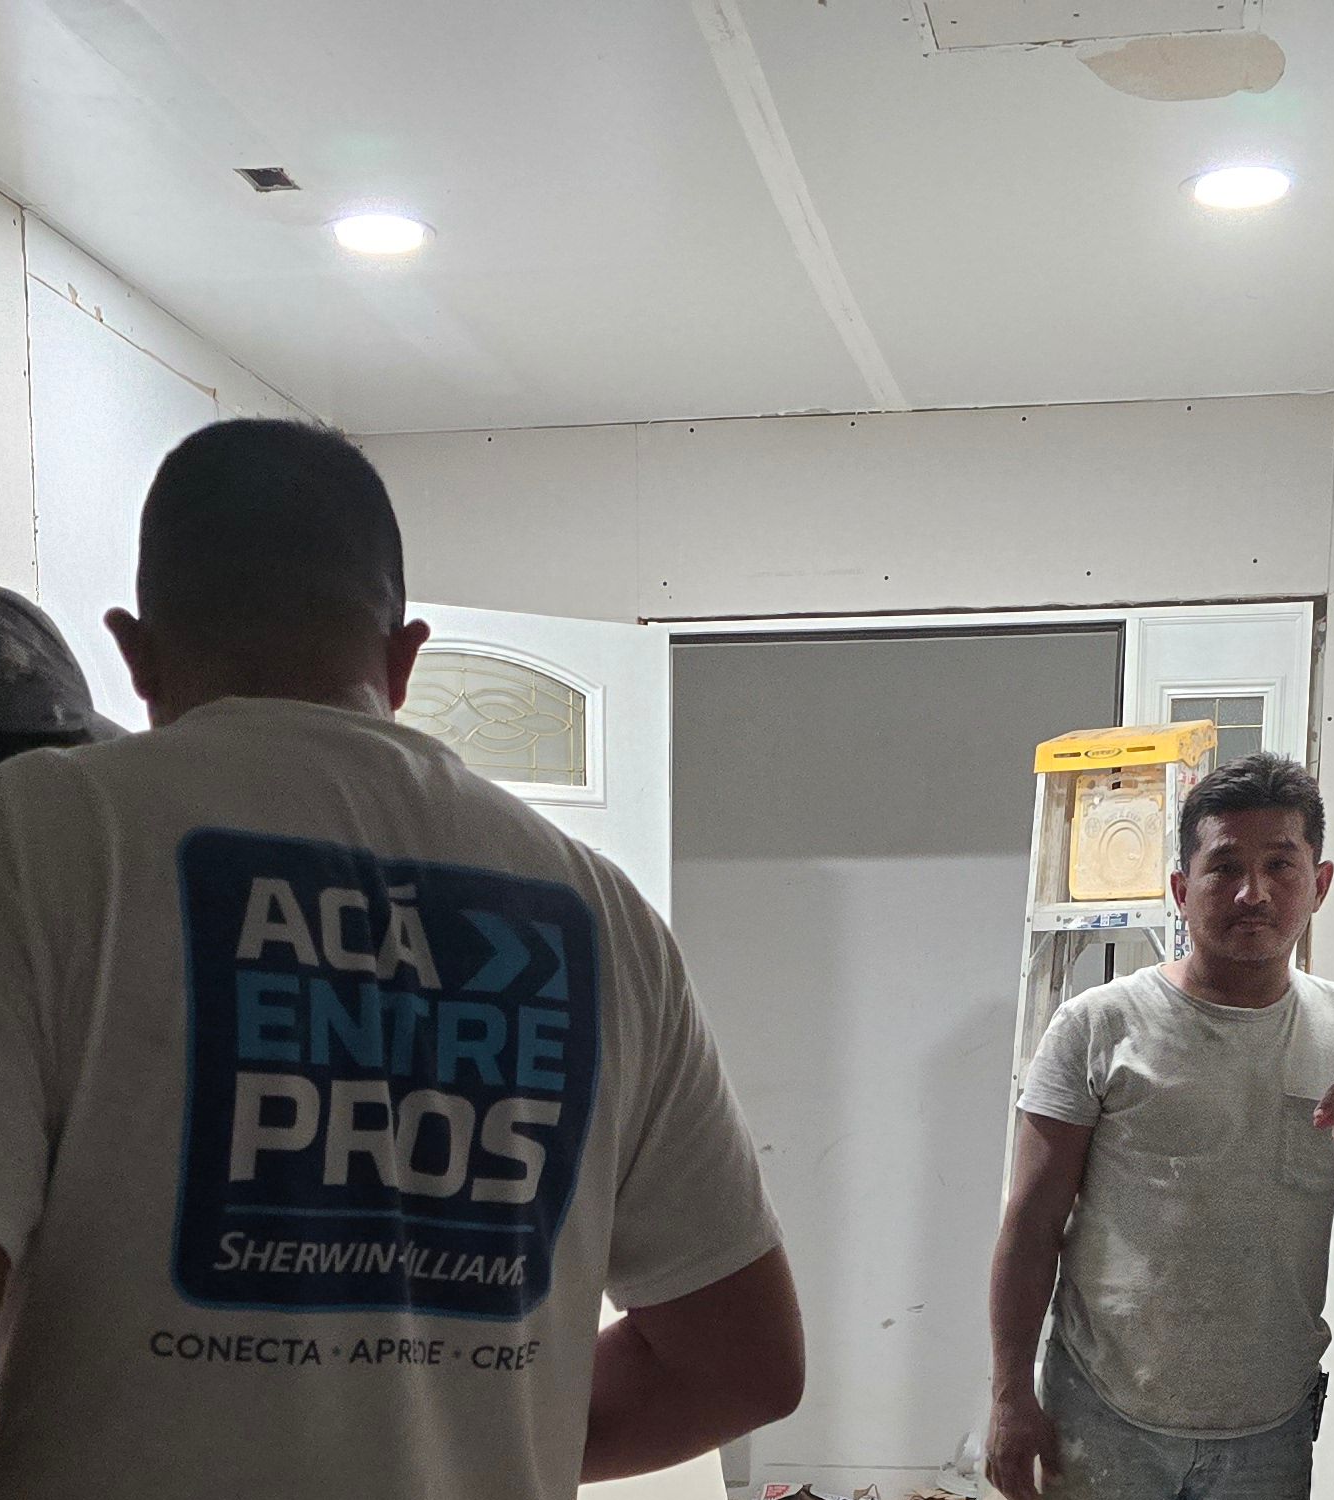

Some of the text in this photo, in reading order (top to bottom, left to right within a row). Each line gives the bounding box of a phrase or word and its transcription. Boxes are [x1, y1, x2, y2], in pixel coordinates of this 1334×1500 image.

[235, 875, 443, 990] ACÁ
[235, 968, 571, 1092] ENTRE
[228, 1070, 563, 1206] PROS
[149, 1331, 323, 1366] CONECTA
